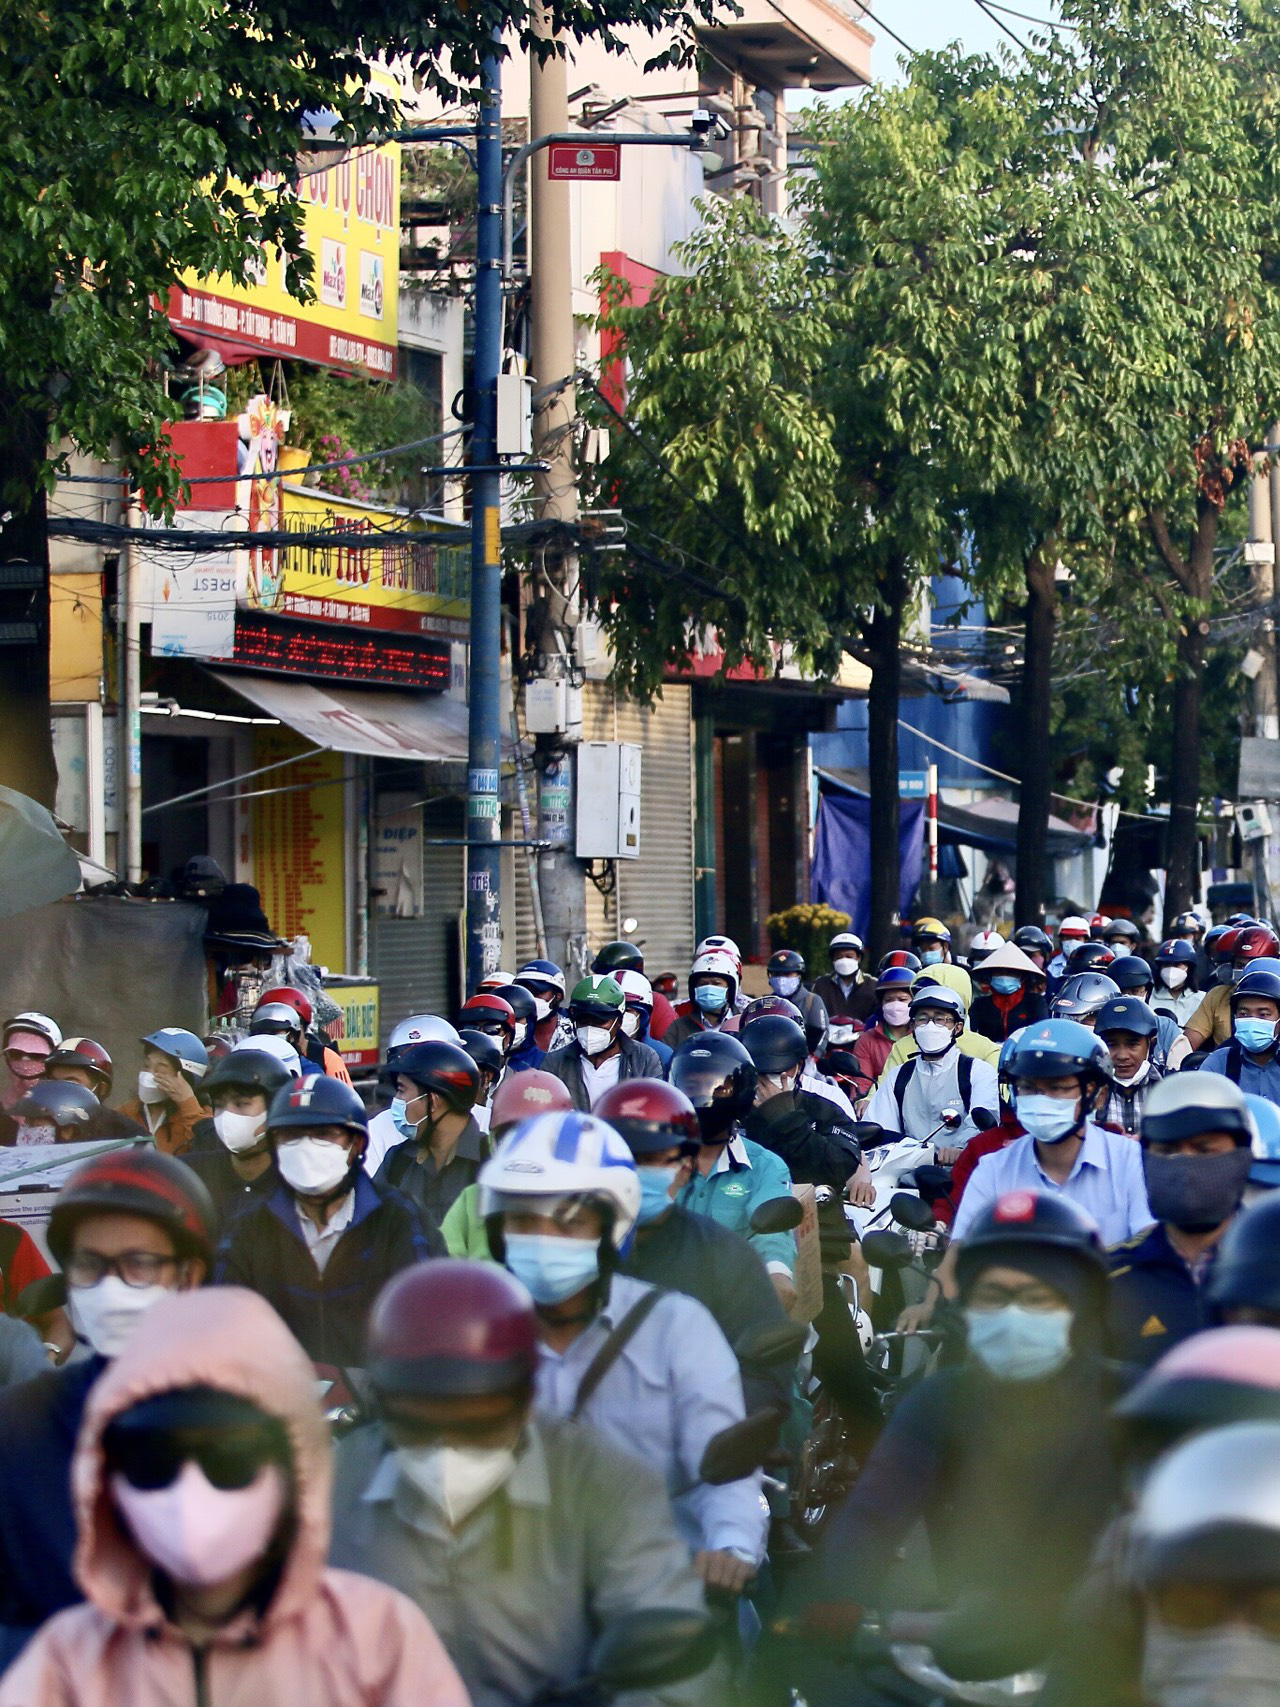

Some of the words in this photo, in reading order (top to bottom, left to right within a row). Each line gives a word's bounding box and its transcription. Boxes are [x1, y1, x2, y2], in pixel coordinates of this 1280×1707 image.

[555, 166, 569, 174] CÔNG
[578, 167, 591, 175] QUẬN
[603, 167, 614, 175] PHÚ
[356, 147, 395, 239] CHỌN
[22, 1205, 33, 1213] the
